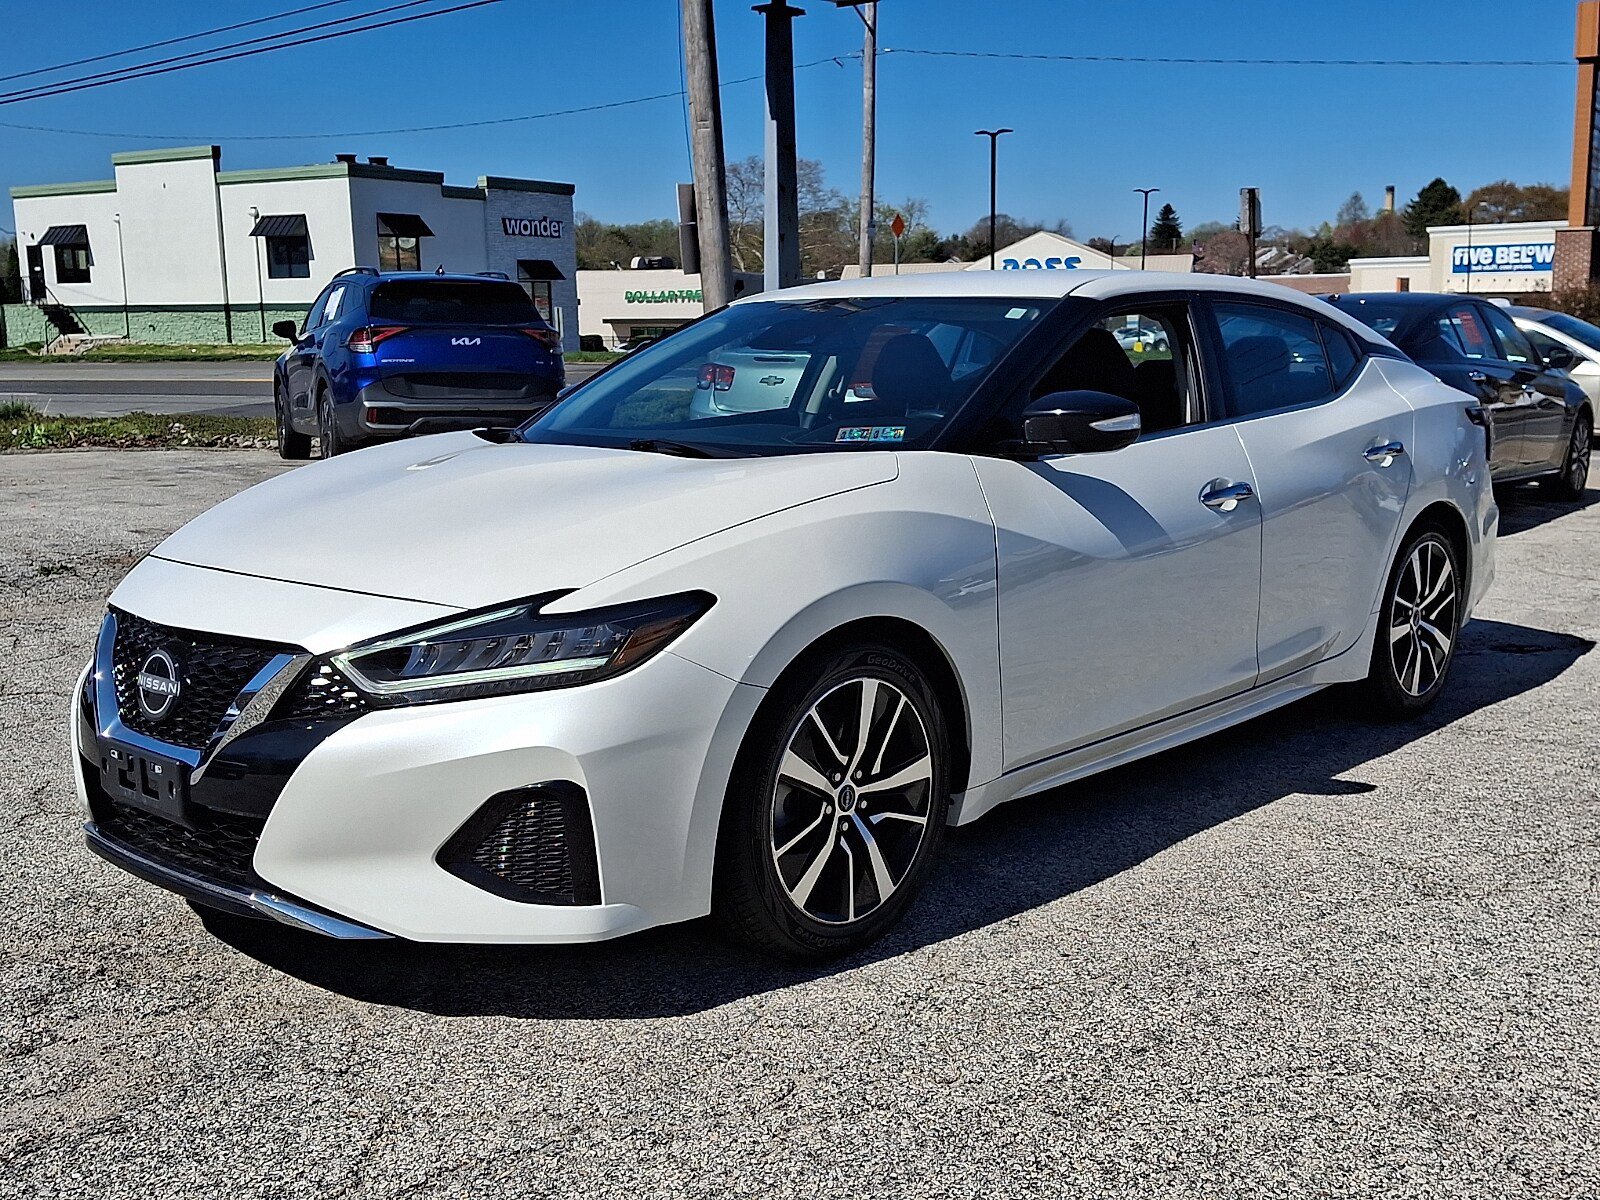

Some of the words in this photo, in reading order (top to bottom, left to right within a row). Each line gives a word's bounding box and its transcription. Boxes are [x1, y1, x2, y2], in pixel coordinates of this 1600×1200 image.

[505, 217, 564, 237] wonder
[1454, 247, 1493, 266] five
[625, 290, 677, 303] DOLLAR
[867, 654, 915, 682] GeoDrive
[138, 674, 177, 694] NISSAN
